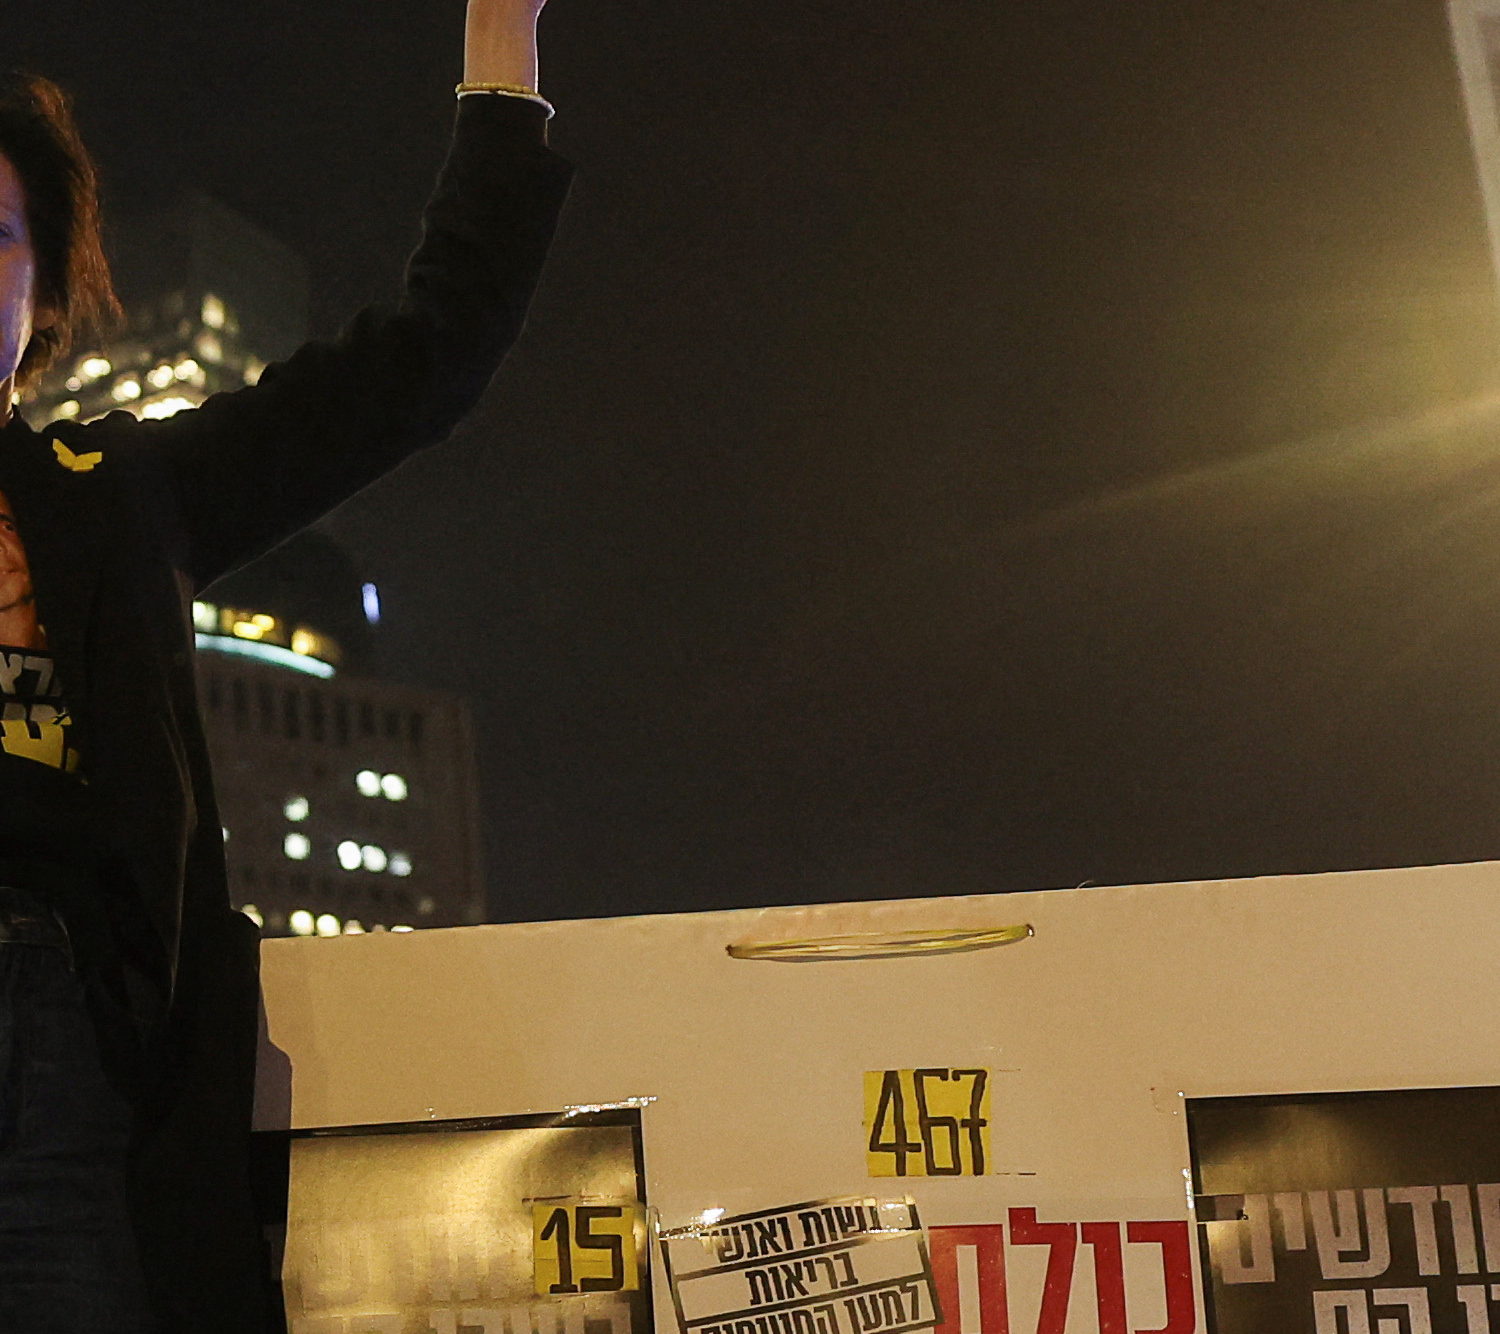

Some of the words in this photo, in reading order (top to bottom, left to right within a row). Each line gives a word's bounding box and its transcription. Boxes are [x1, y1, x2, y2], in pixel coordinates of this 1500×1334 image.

[869, 1069, 988, 1176] 467
[540, 1206, 625, 1295] 15
[745, 1252, 859, 1306] בריאות
